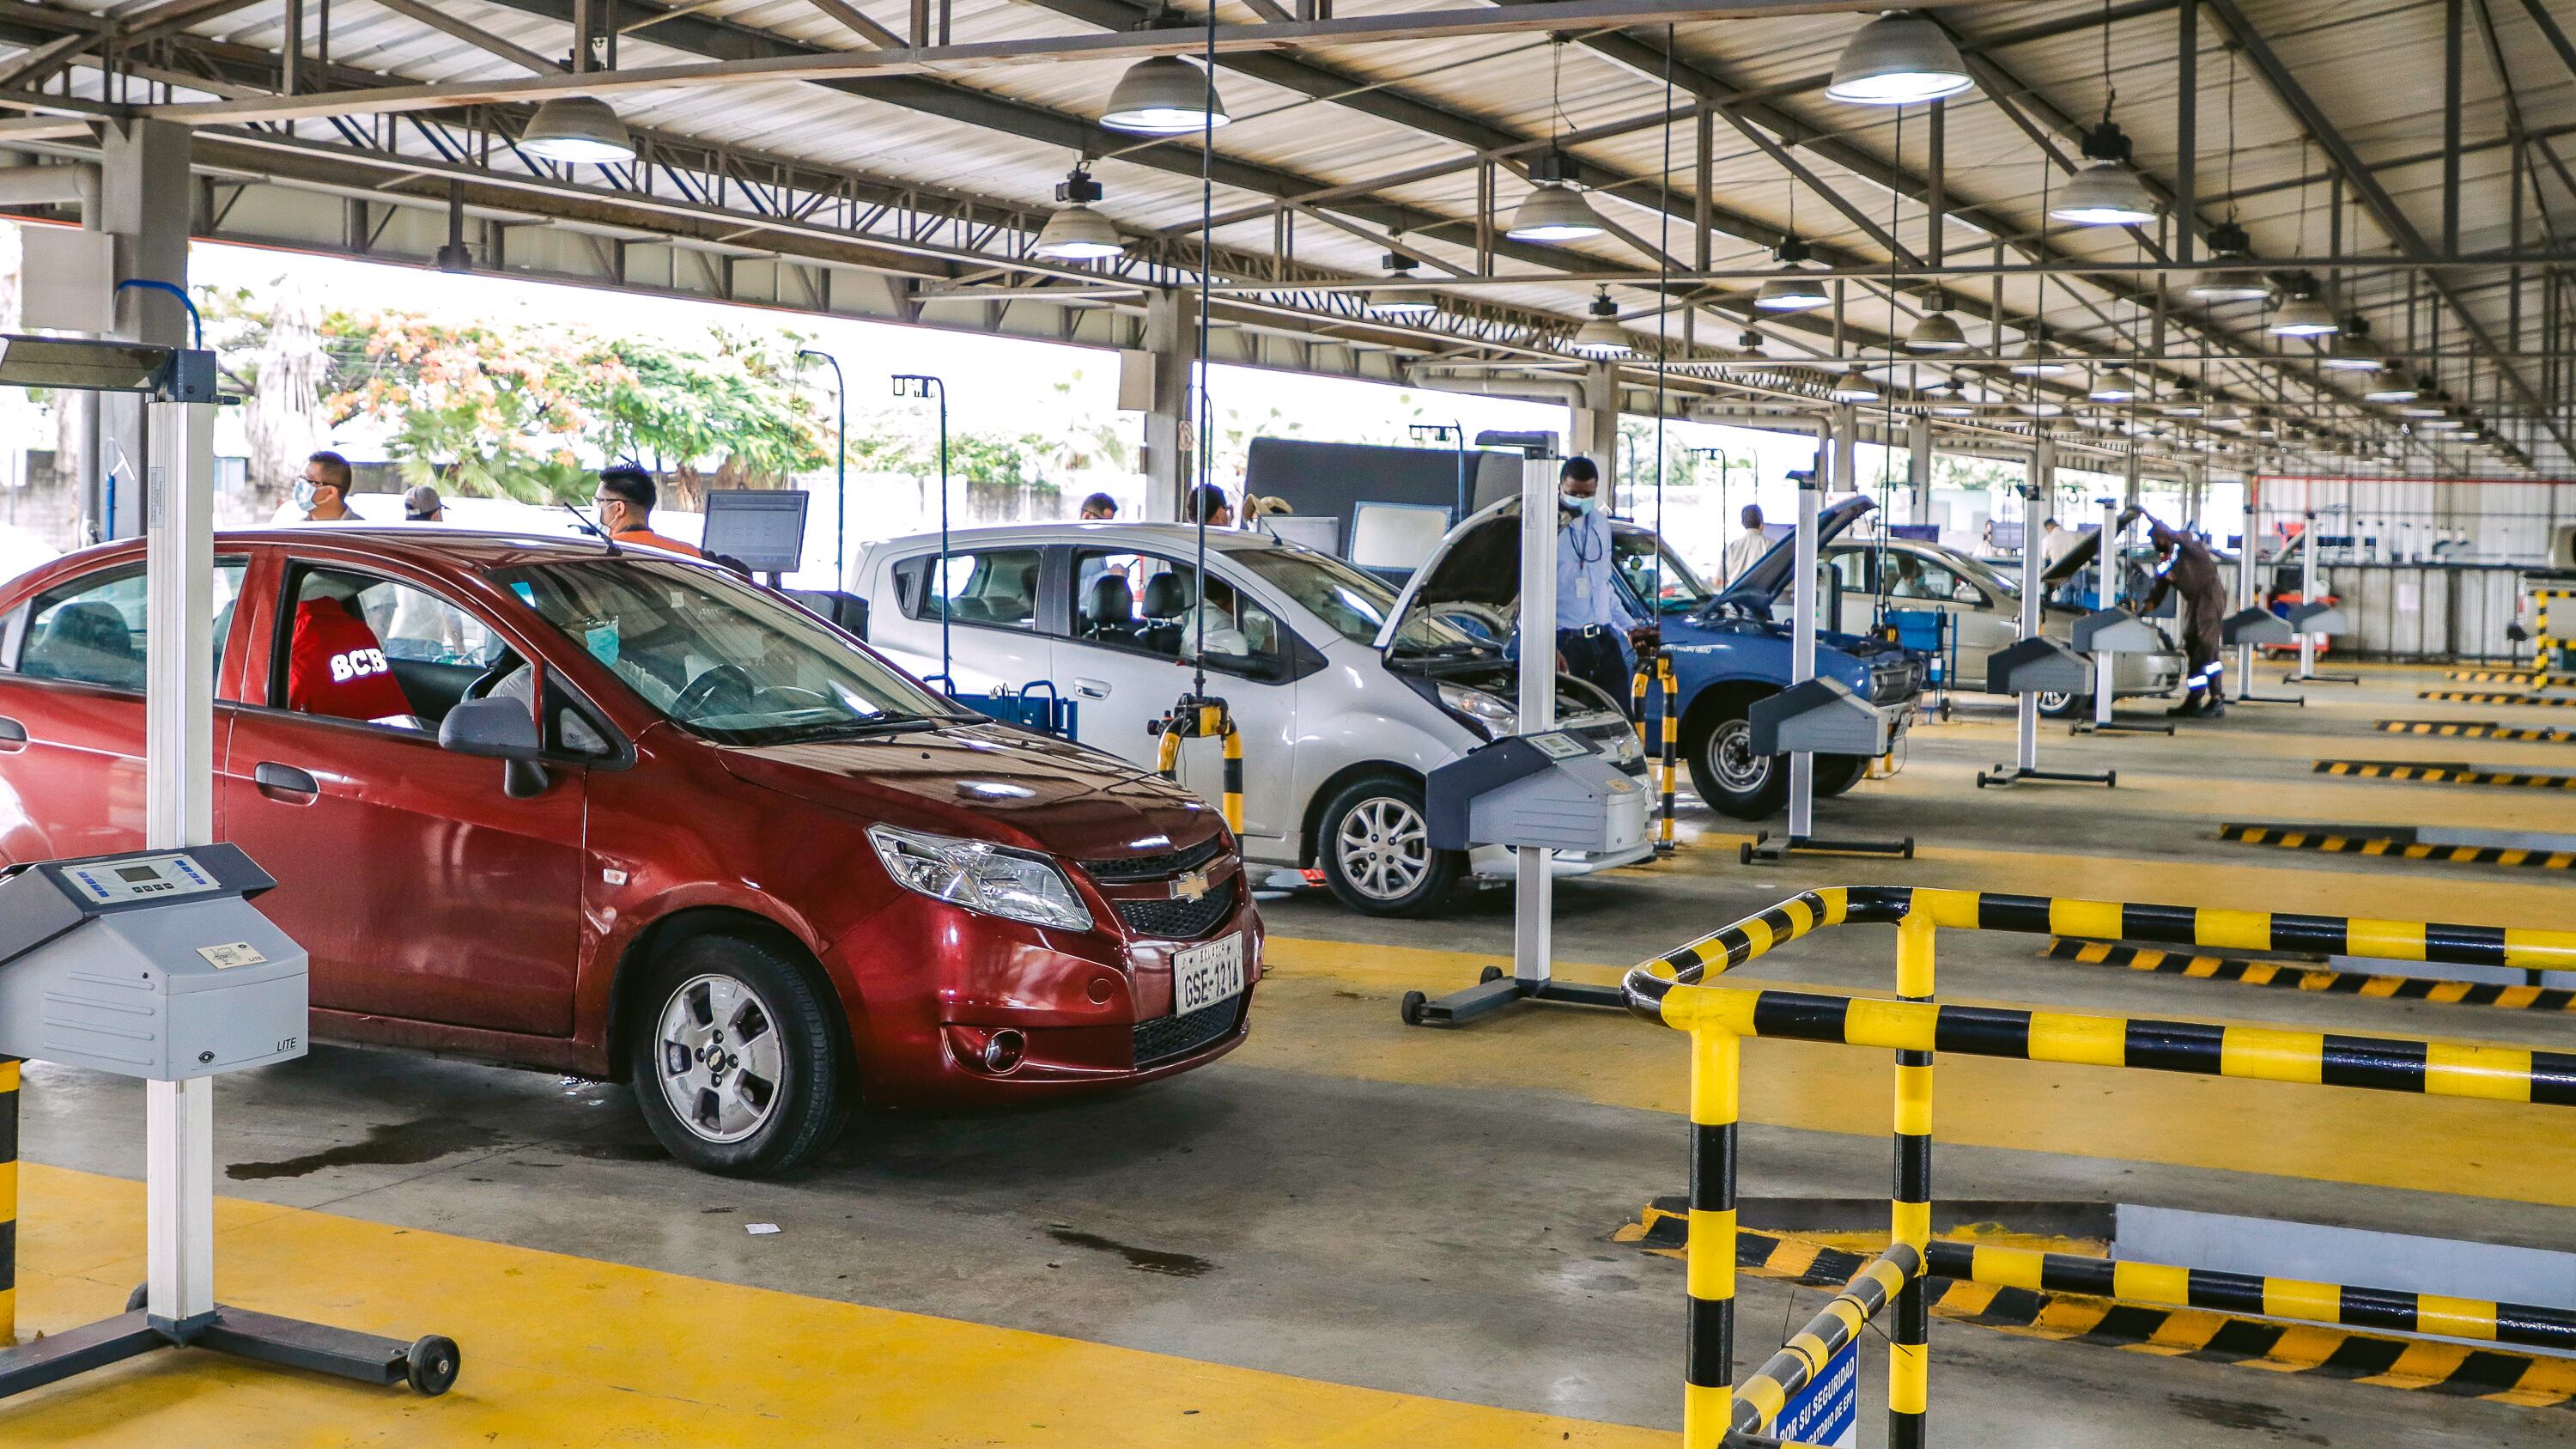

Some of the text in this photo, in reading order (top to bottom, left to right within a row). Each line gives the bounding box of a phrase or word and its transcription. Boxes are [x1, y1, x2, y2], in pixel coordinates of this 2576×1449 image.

[1185, 958, 1238, 1008] GSE-1214
[276, 1038, 296, 1051] LITE
[1799, 1402, 1812, 1431] SU
[1813, 1356, 1854, 1416] SEGURIDAD
[1835, 1402, 1843, 1422] DE
[1844, 1389, 1853, 1411] EPP
